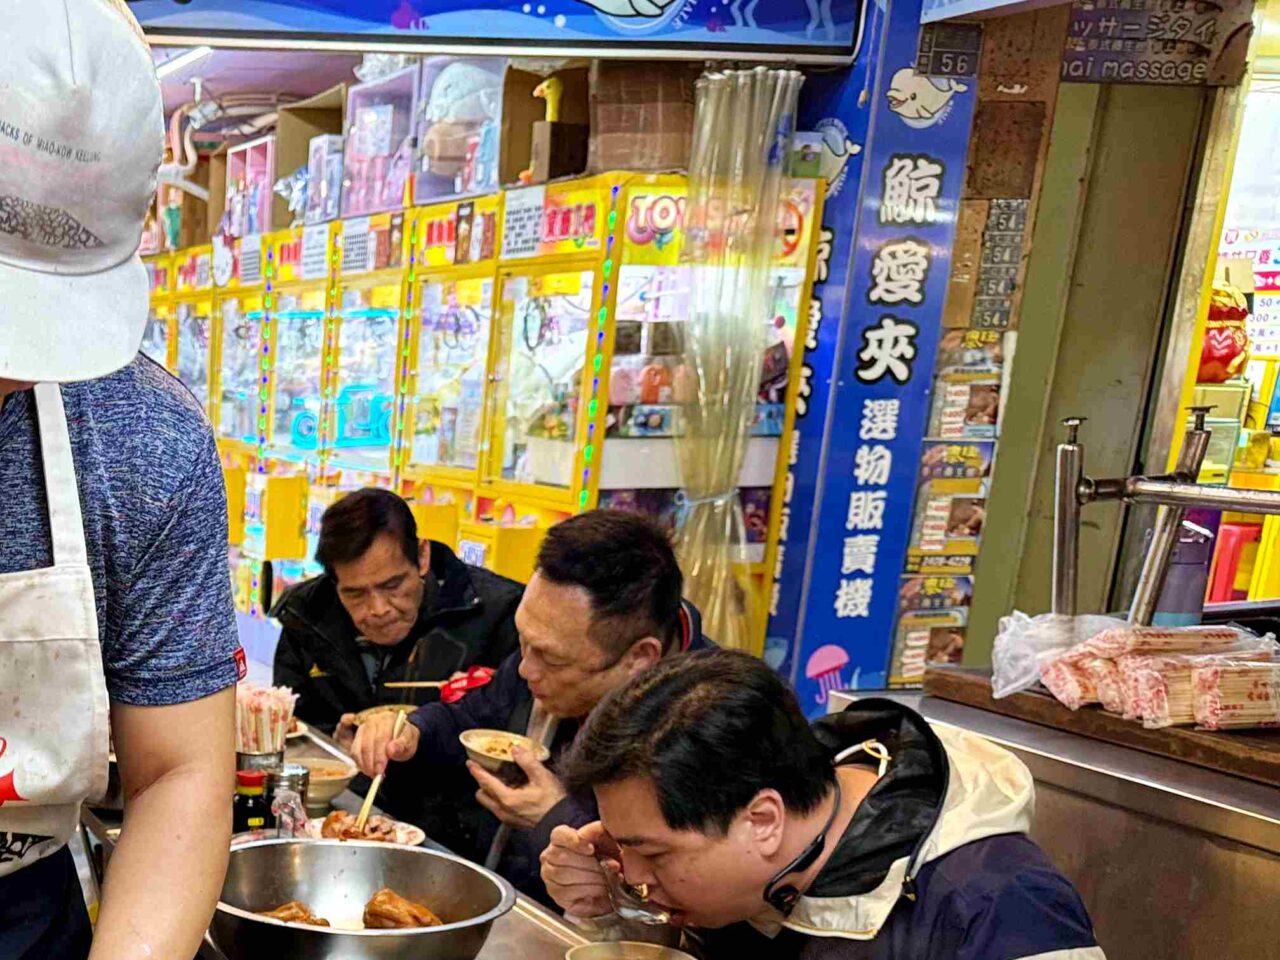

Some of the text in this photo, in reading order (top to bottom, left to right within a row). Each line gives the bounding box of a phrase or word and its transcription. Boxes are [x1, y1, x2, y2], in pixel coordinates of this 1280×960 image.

[941, 53, 969, 73] 56
[1101, 60, 1208, 84] massage
[22, 131, 33, 146] OF
[857, 157, 945, 383] 鯨愛夾
[834, 398, 900, 618] 選物販賣機
